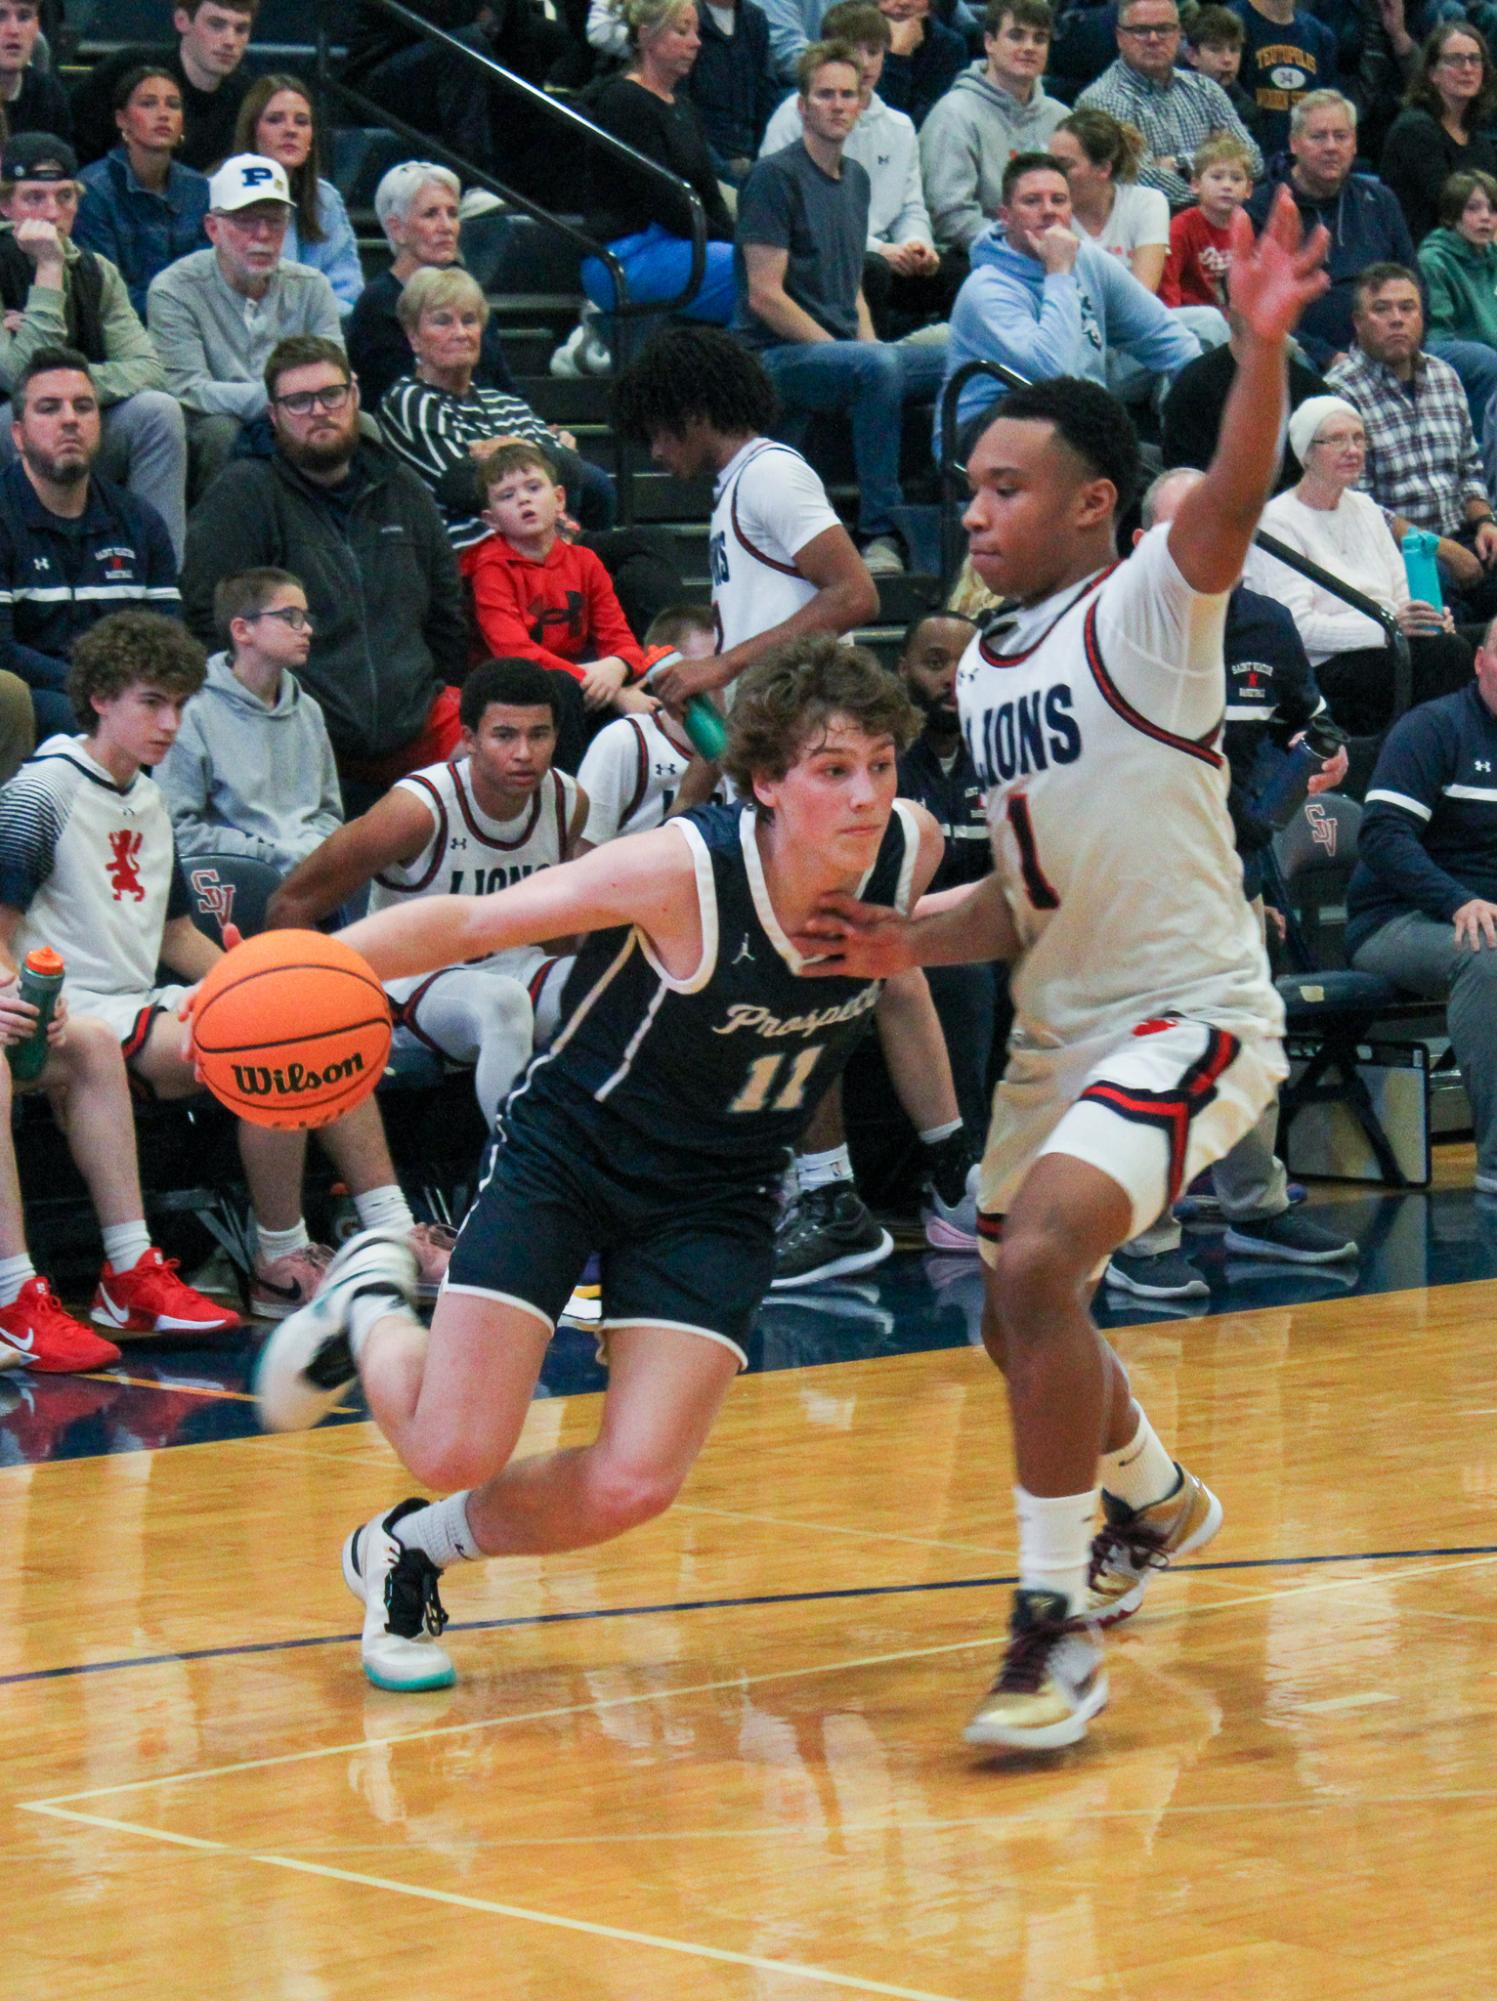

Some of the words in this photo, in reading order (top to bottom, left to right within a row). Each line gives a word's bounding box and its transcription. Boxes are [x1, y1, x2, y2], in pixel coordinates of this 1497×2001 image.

[241, 167, 273, 187] P
[1006, 793, 1061, 911] 1
[230, 1052, 365, 1095] Wilson
[727, 1044, 826, 1113] 11
